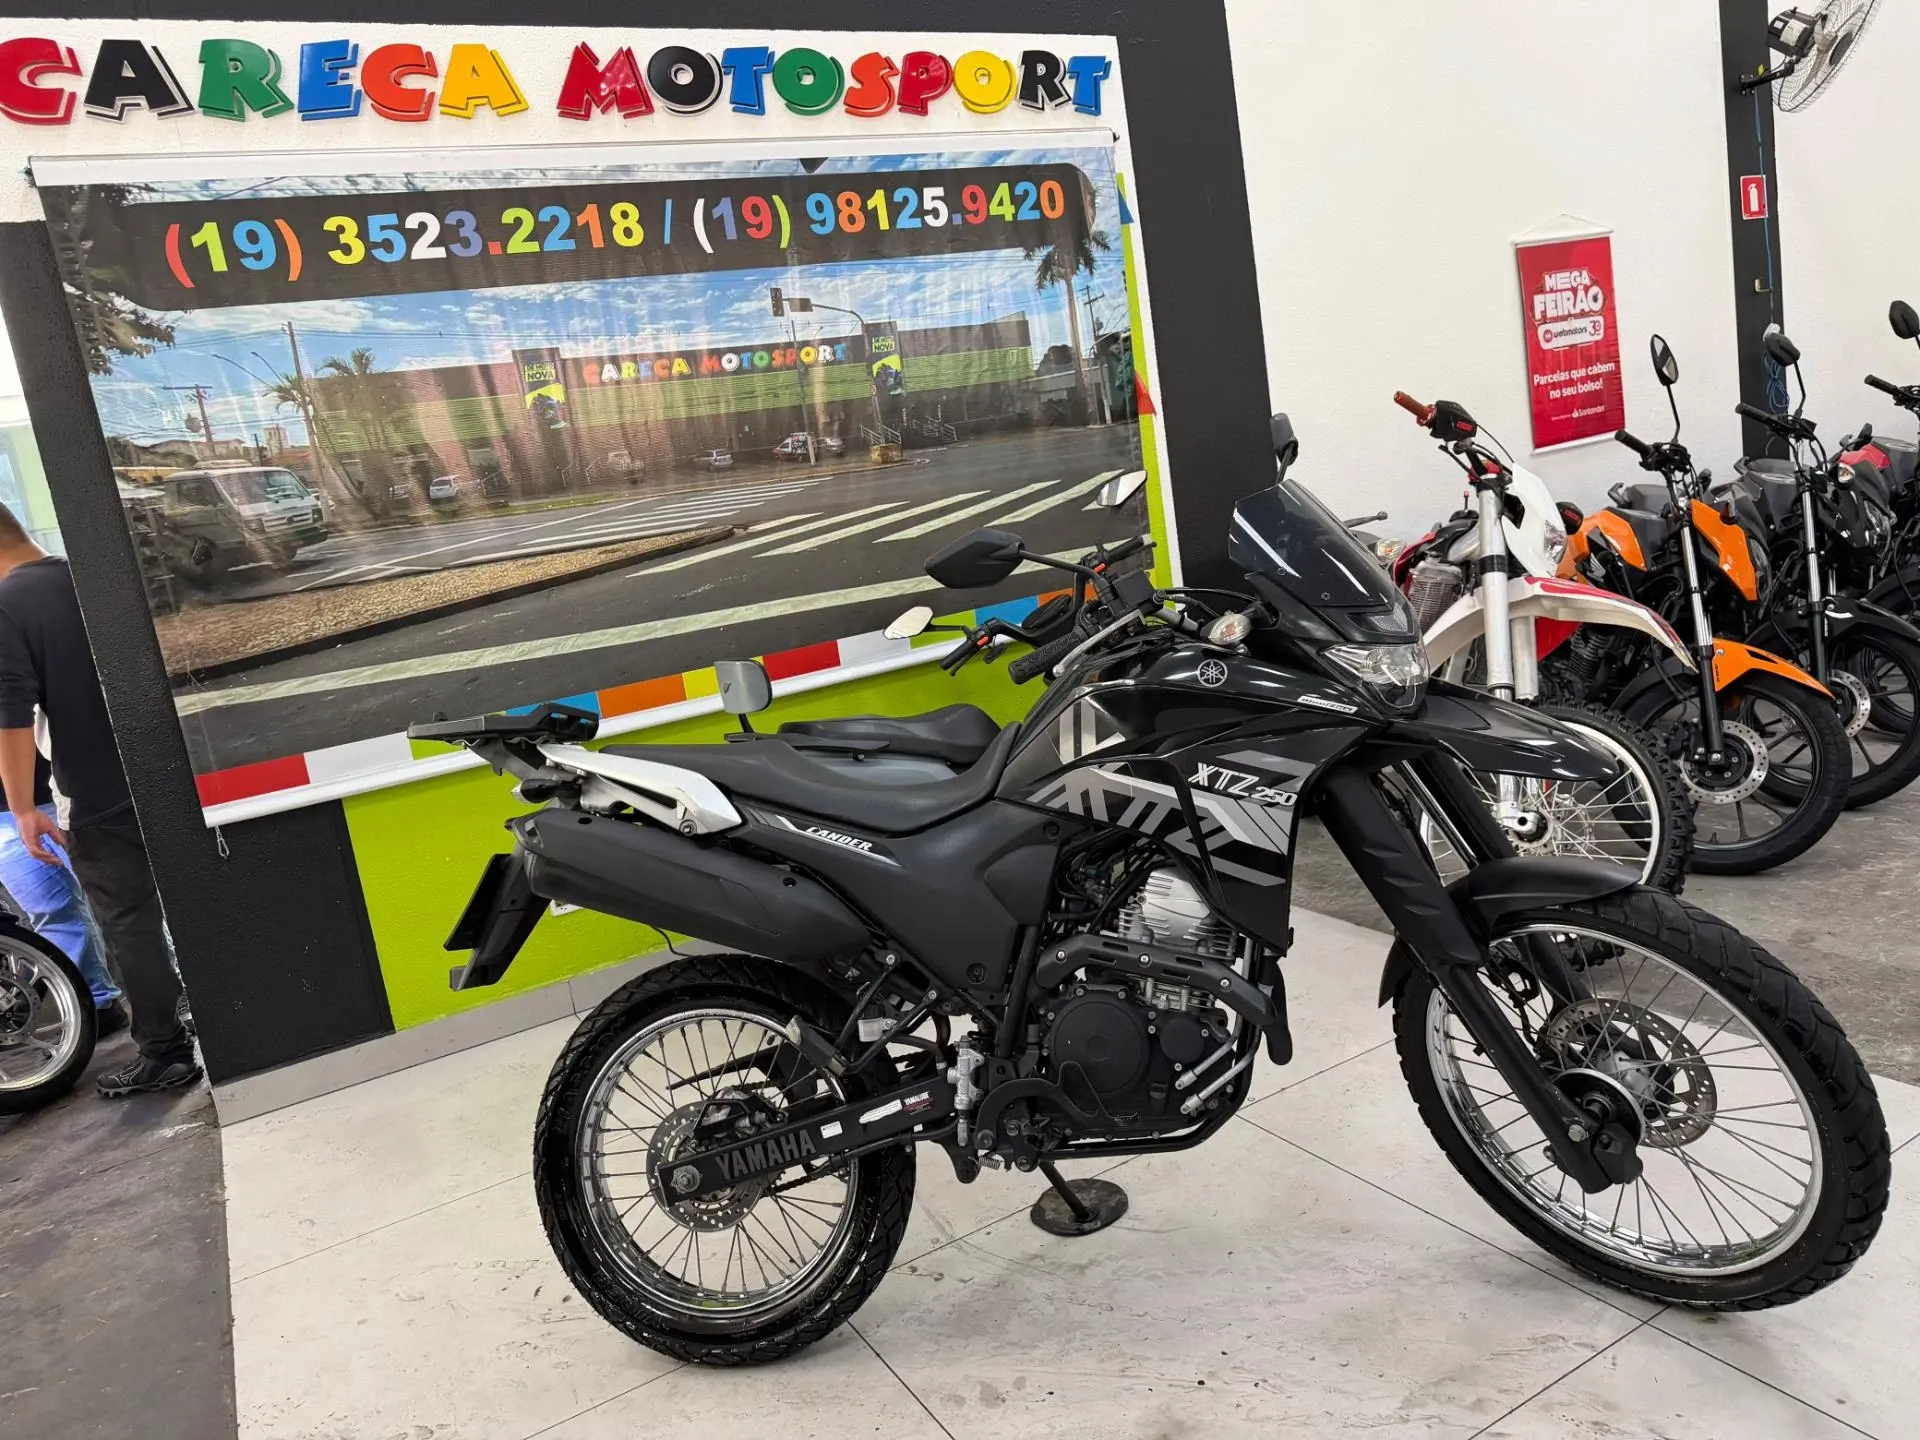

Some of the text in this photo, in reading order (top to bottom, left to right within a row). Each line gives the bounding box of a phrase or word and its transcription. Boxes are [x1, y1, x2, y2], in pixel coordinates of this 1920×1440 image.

[0, 37, 1111, 125] CARECA MOTOSPORT
[165, 219, 302, 288] (19)
[323, 202, 644, 265] 3523.2218
[693, 195, 790, 254] (19)
[806, 180, 1064, 236] 98125.9420
[1544, 270, 1591, 291] MEGA
[1533, 285, 1603, 320] FEIRÃO
[526, 370, 554, 381] NOVA
[583, 343, 847, 385] CARECA MOTOSPORT
[1533, 362, 1615, 386] Parcelas que cabem
[1549, 377, 1603, 400] no seu bolso!
[1578, 405, 1606, 417] Santander
[1188, 762, 1298, 806] XTZ 250
[806, 826, 873, 850] LANDER
[716, 1130, 816, 1180] YAMAHA
